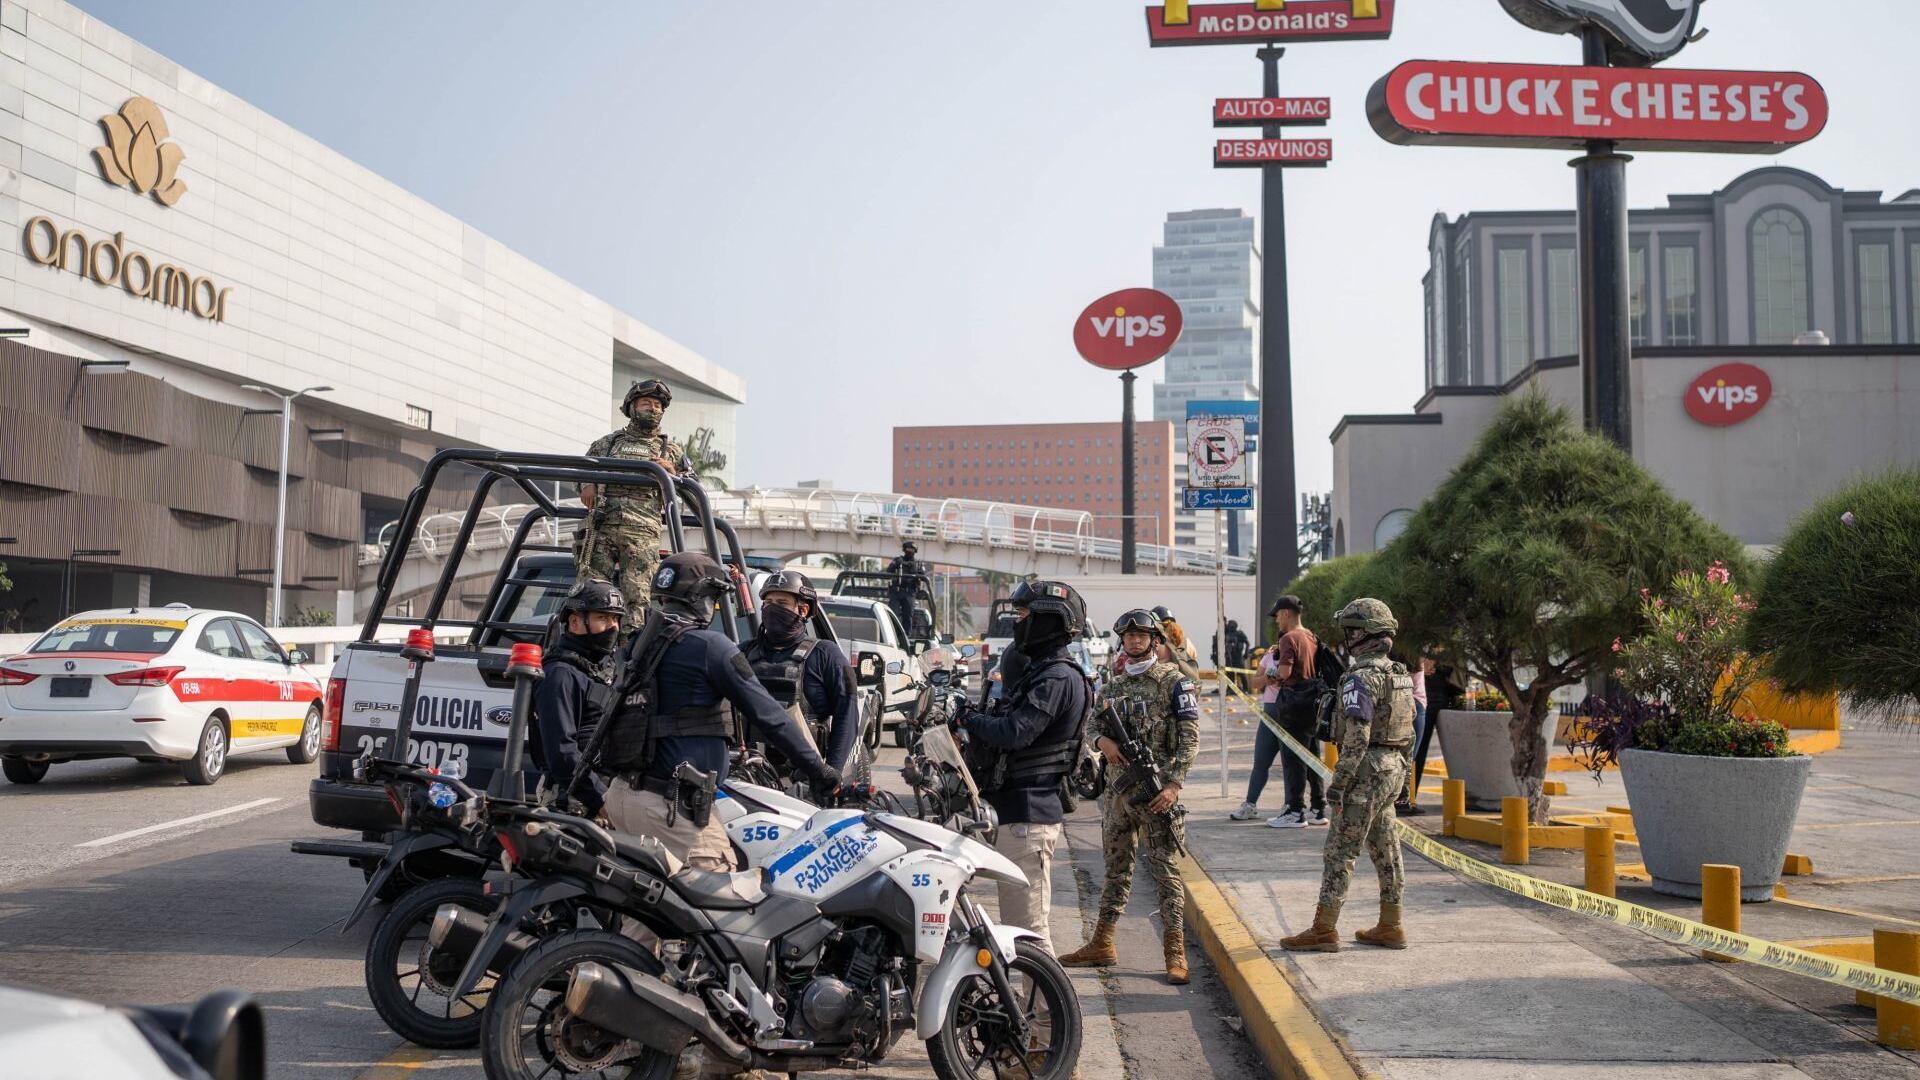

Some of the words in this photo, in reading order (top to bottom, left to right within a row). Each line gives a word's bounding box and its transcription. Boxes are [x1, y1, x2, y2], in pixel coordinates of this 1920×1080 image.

[1199, 12, 1348, 33] McDonald's
[1221, 101, 1328, 116] AUTO-MAC
[1405, 72, 1563, 121] CHUCK
[1571, 78, 1611, 127] E.
[1610, 81, 1809, 131] CHEESE'S
[1221, 141, 1329, 157] DESAYUNOS
[23, 215, 234, 322] andamar
[1090, 306, 1166, 347] vips
[1697, 379, 1758, 411] vips
[621, 446, 649, 454] MARINA
[280, 680, 294, 701] TAXI
[1178, 693, 1198, 708] PN
[415, 695, 483, 731] OLICIA
[742, 825, 780, 843] 356
[911, 873, 931, 887] 35
